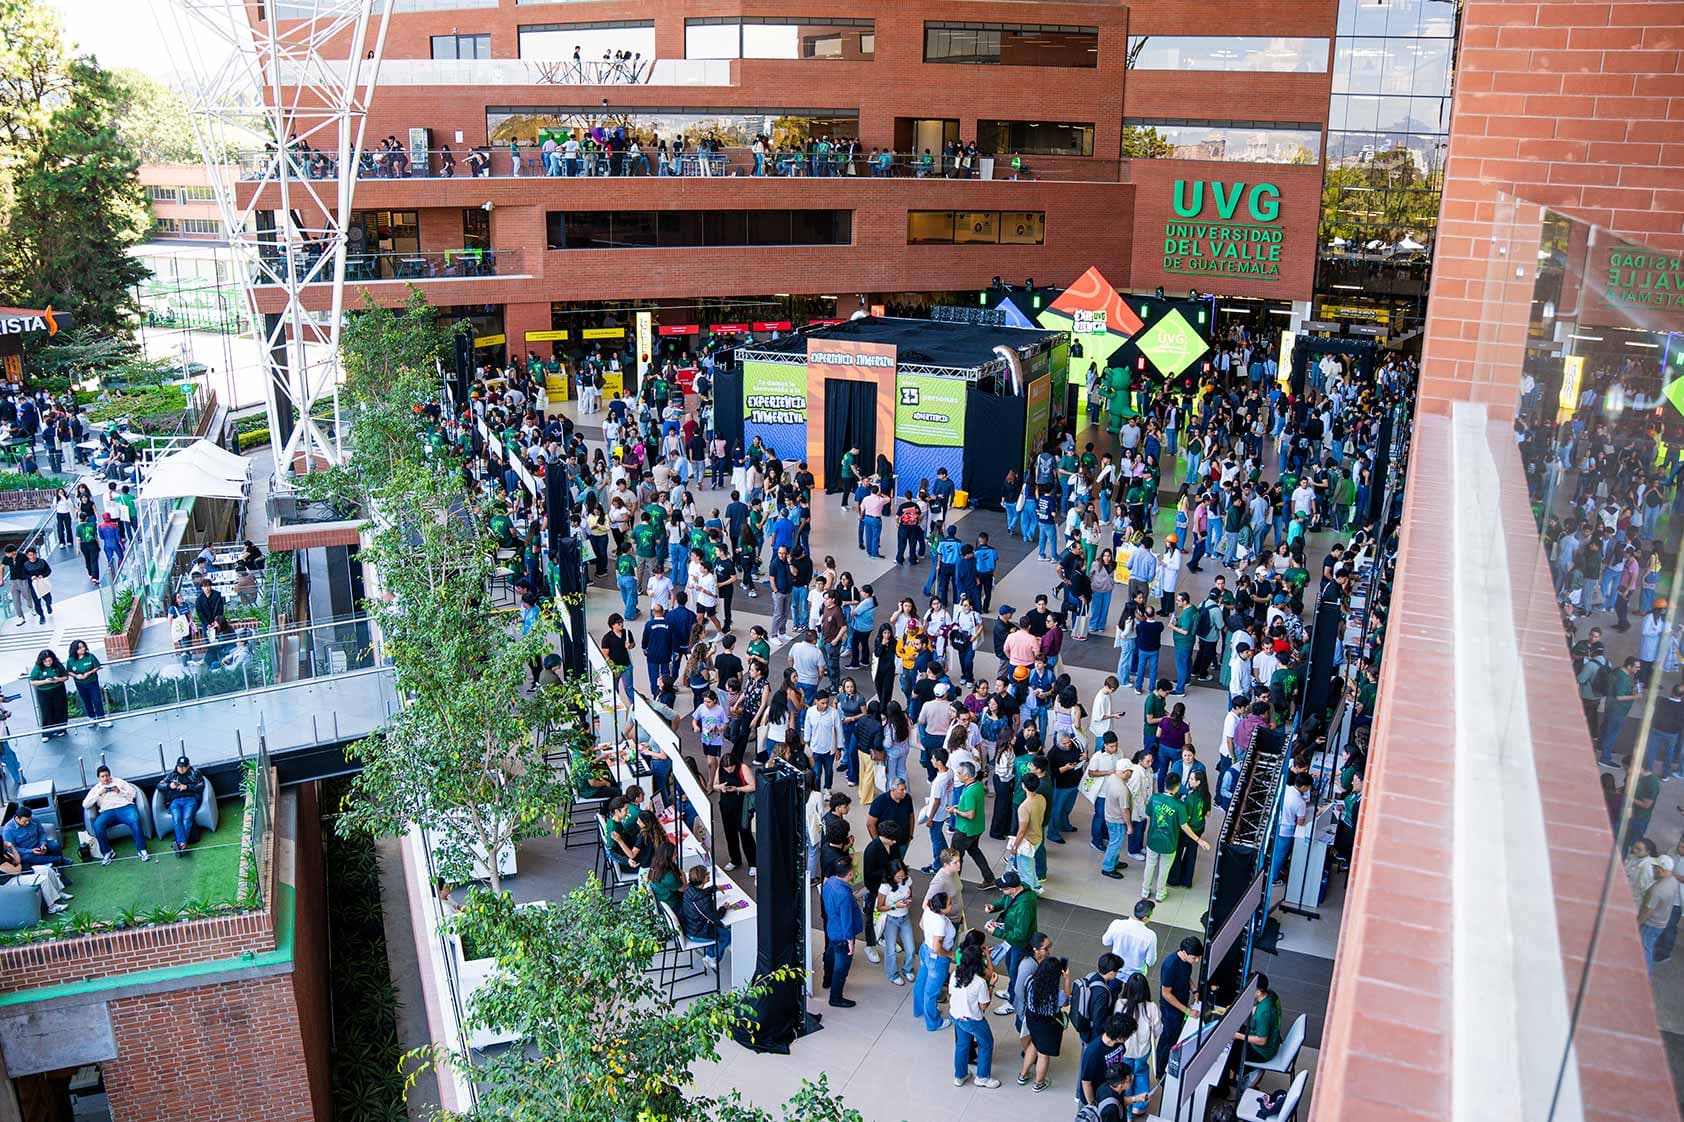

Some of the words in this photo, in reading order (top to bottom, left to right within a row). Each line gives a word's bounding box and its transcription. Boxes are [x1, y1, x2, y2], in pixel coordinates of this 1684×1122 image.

[1173, 179, 1281, 222] UVG
[1165, 224, 1283, 243] UNIVERSIDAD
[1164, 239, 1203, 257] DEL
[1210, 241, 1282, 262] VALLE
[1163, 256, 1182, 269] DE
[1188, 258, 1280, 275] GUATEMALA
[1158, 333, 1185, 345] UVG
[811, 352, 853, 366] EXPERIENCIA
[855, 353, 894, 368] INMERSIVA
[747, 395, 806, 409] EXPERIENCIA
[752, 410, 804, 424] INMERSIVA
